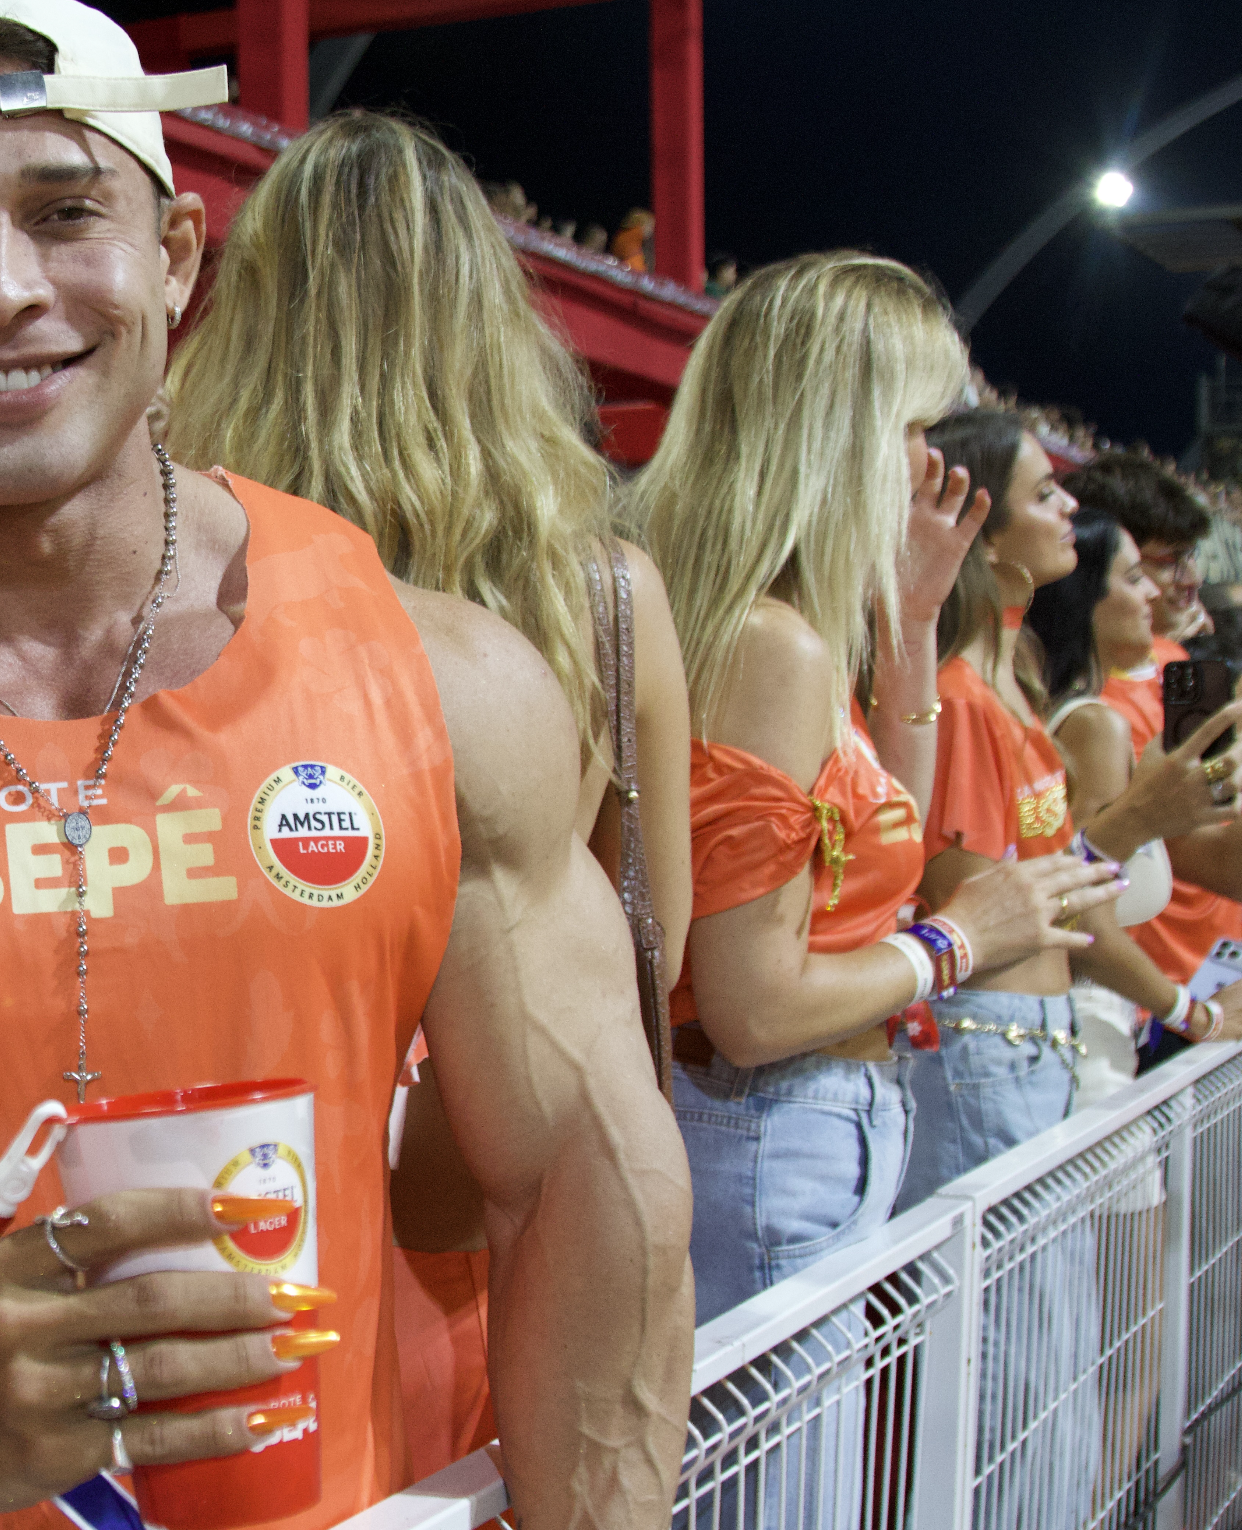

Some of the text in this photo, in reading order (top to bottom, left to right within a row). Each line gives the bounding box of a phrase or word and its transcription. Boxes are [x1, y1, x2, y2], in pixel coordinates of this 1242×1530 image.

[253, 775, 364, 830] PREMIUM BIER
[277, 812, 360, 833] AMSTEL
[299, 840, 346, 854] LAGER
[266, 832, 382, 903] AMSTERDAM HOLLAND
[249, 1216, 288, 1234] LAGER
